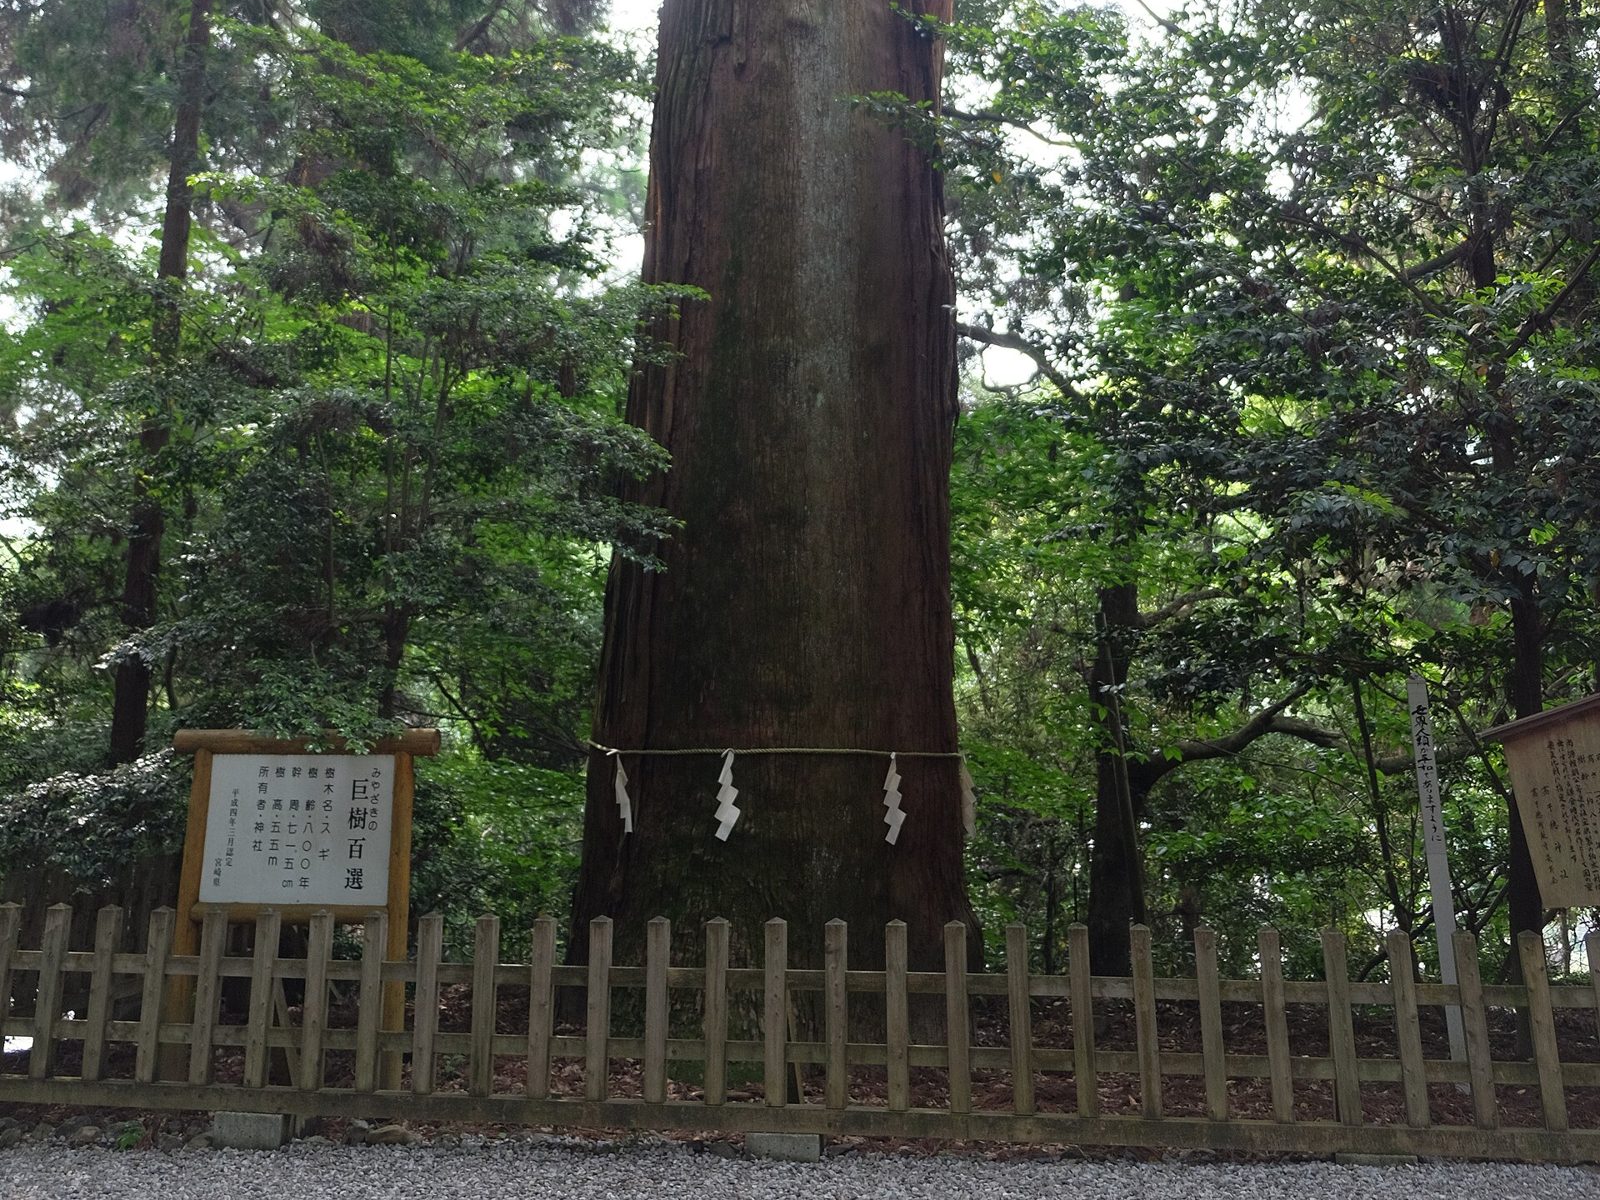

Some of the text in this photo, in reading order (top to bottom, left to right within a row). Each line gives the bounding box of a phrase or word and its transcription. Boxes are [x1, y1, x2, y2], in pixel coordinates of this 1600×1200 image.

[252, 765, 269, 852] 所有者・神社
[318, 767, 336, 861] 樹木名・スギ
[368, 767, 382, 831] みやざきの
[1411, 704, 1442, 842] 世界人類が平和でありますように
[212, 858, 223, 887] 宮崎県
[344, 777, 369, 891] 巨樹百選
